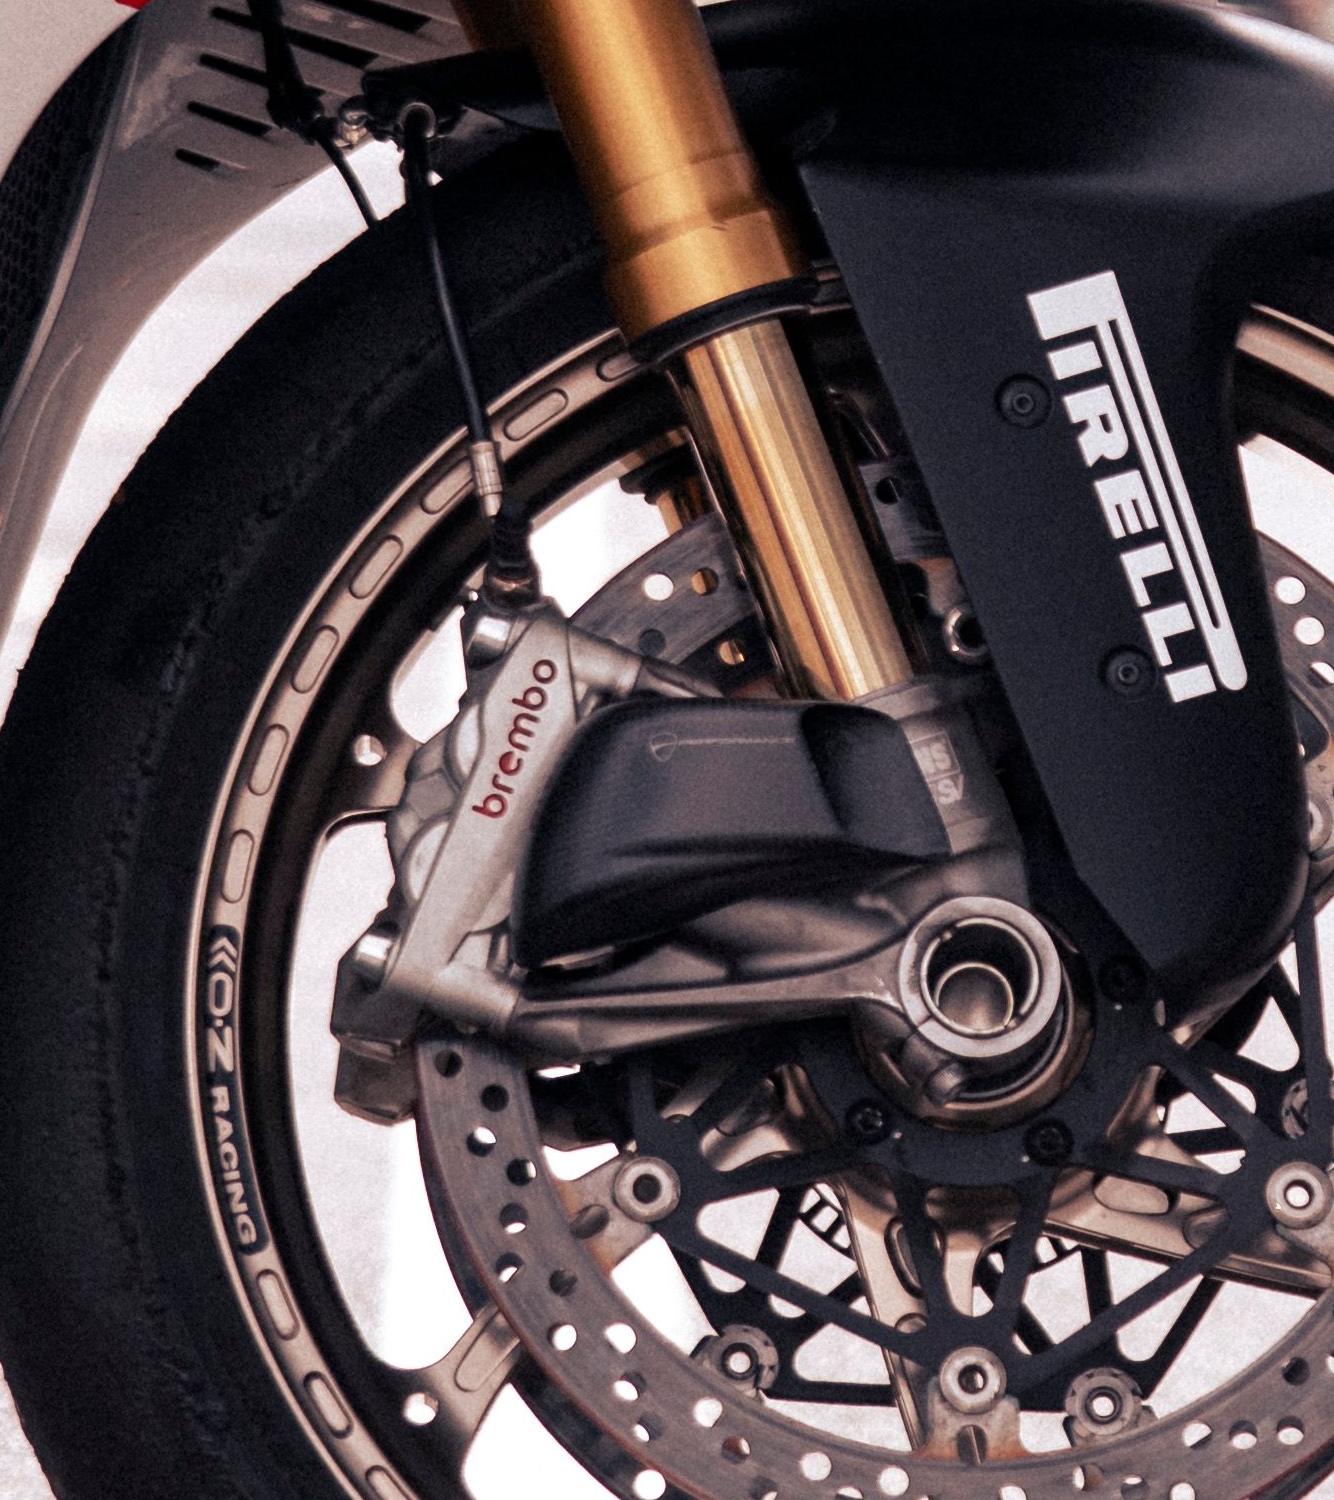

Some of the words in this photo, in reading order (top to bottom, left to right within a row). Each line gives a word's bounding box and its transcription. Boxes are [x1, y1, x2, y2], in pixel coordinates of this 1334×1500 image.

[1027, 270, 1248, 703] PIRELLI
[473, 658, 558, 819] brembo
[209, 1085, 259, 1247] RACING
